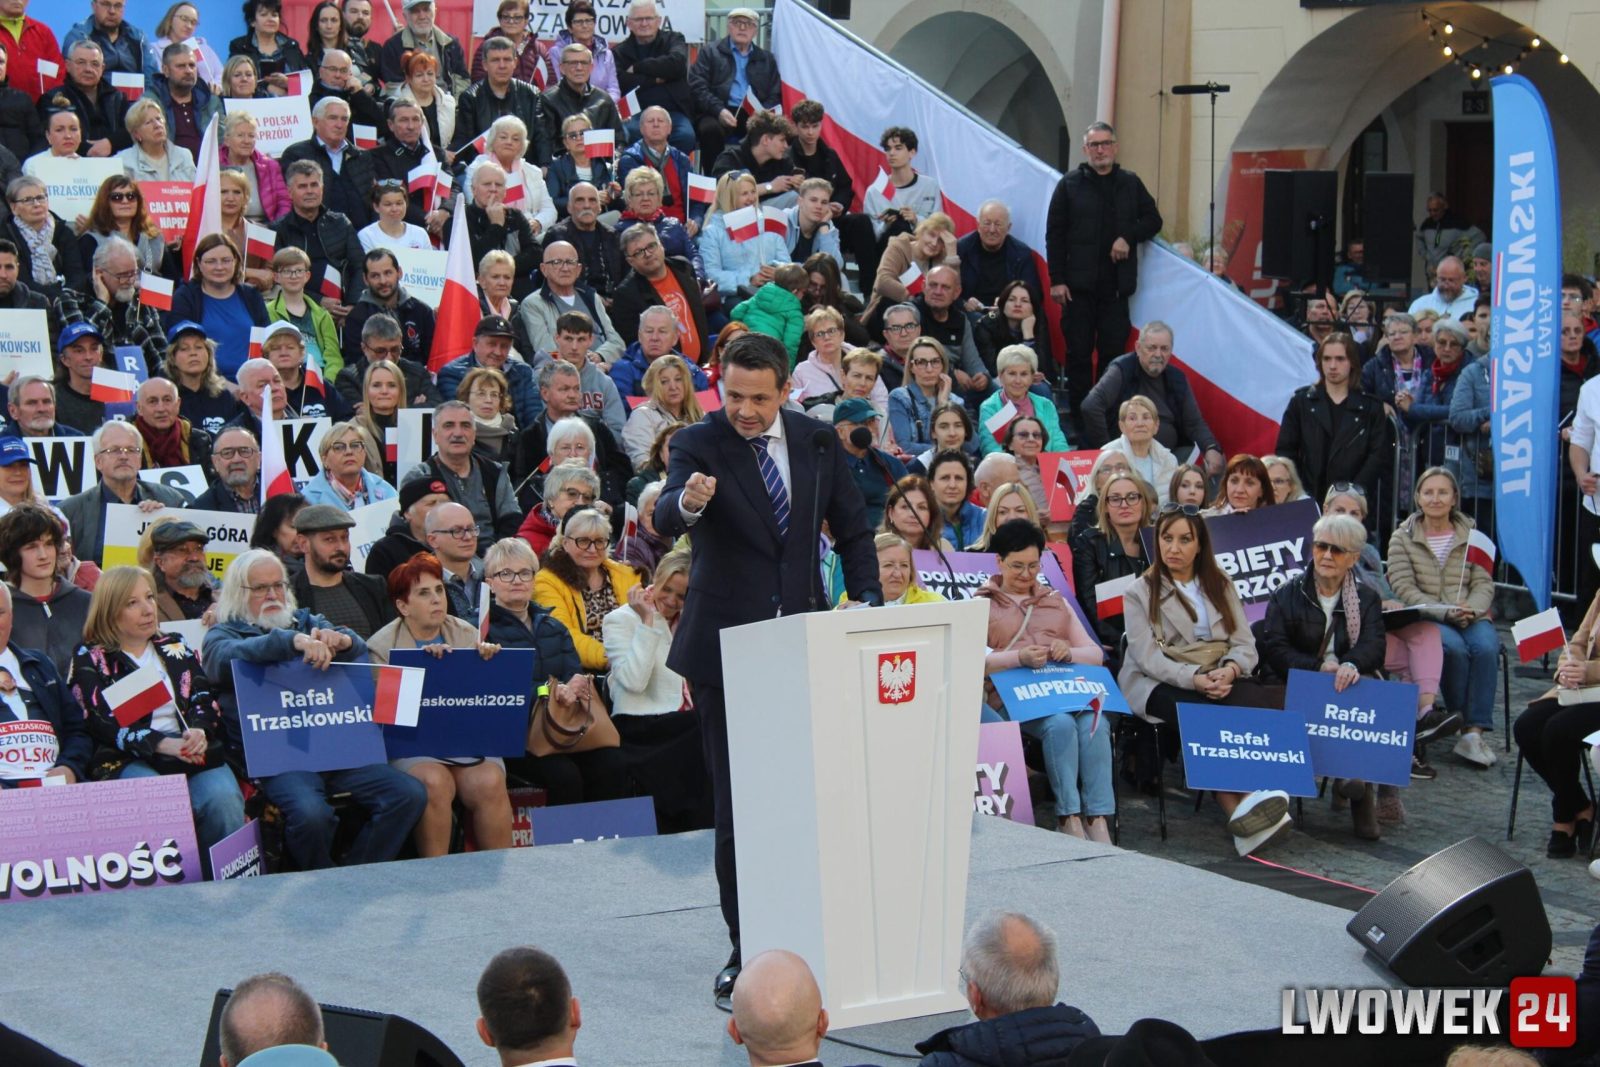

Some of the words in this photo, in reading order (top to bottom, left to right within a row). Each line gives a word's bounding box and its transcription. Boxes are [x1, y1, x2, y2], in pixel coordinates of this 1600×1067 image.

[263, 114, 299, 128] POLSKA
[149, 201, 173, 214] CAŁA
[0, 340, 42, 354] KOWSKI
[282, 421, 321, 478] K
[31, 441, 85, 496] W
[206, 523, 249, 543] GÓRA
[1214, 536, 1305, 577] BIETY
[280, 687, 335, 709] Rafał
[1013, 676, 1110, 701] NAPRZÓD!
[247, 704, 373, 732] Trzaskowski
[1324, 703, 1376, 725] Rafał
[1219, 729, 1271, 747] Rafał
[1305, 721, 1409, 748] zaskowski
[1188, 742, 1306, 765] Trzaskowski
